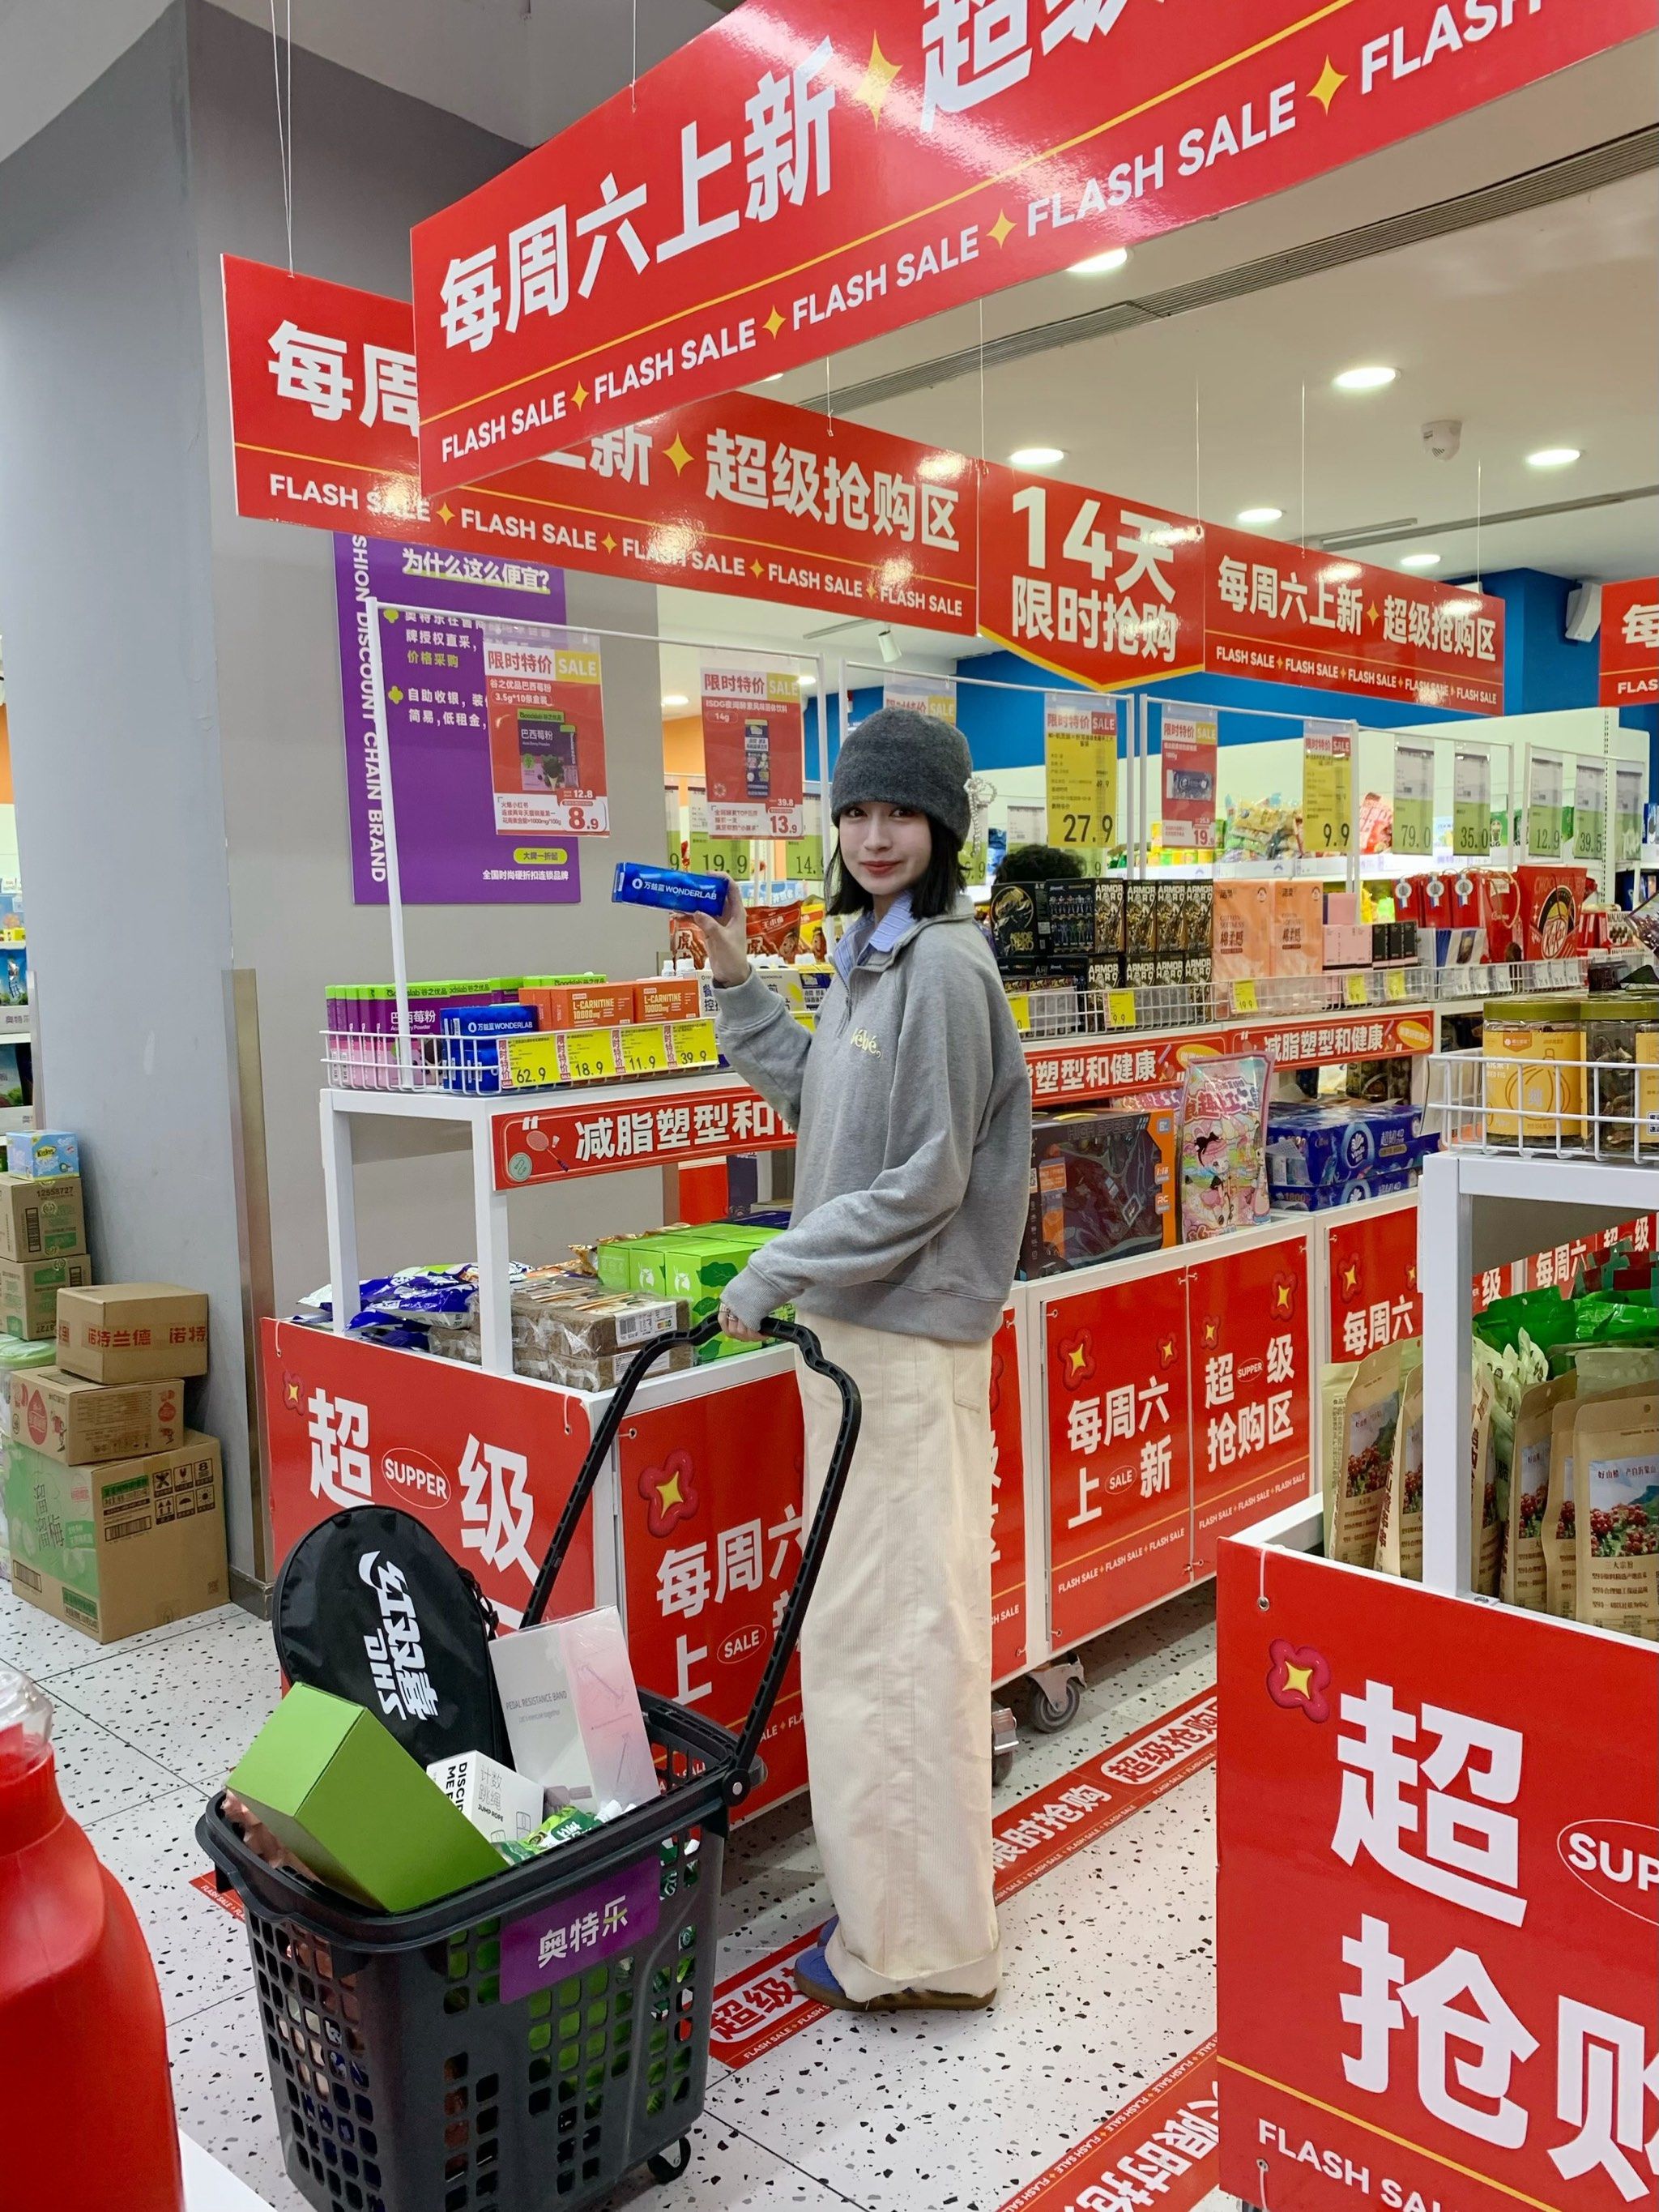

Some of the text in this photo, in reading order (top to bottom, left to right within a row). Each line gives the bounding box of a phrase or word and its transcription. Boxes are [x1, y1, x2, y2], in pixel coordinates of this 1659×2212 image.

[440, 0, 1129, 353] 每周六上新 超
[441, 421, 505, 463] FLASH
[511, 391, 566, 436] SALE
[594, 348, 673, 404] FLASH
[680, 318, 756, 370] SALE
[792, 263, 887, 331] FLASH
[896, 228, 979, 288] SALE
[1026, 144, 1164, 237] FLASH
[1177, 80, 1297, 177] SALE
[705, 427, 960, 553] 超级抢购区
[269, 473, 962, 617] FLASH SALE FLASH SALE FLASH SALE FLASH SALE FLASH SALE
[1012, 485, 1177, 604] 14天
[1011, 575, 1177, 663] 限时抢购
[1218, 554, 1496, 662] 每周六上新 超级抢购区
[488, 651, 597, 677] 限时特价 SALE
[1216, 646, 1248, 664] FLASH
[1251, 652, 1275, 669] SALE
[1285, 657, 1314, 677] FLASH
[1316, 663, 1338, 679] SALE
[1348, 668, 1375, 685] FLASH
[1376, 673, 1397, 688] SALE
[1456, 687, 1479, 702] FLASH
[1480, 690, 1497, 705] SALE
[705, 673, 799, 696] 限时特价 SALE
[1048, 713, 1115, 731] 限时特价 SALE
[1164, 723, 1216, 740] 限时特价 SALE
[356, 611, 386, 882] DISCOUNT CHAIN BRAND
[1333, 739, 1350, 752] SALE
[574, 790, 593, 798] 12.8
[569, 807, 599, 830] 8.9
[770, 815, 797, 834] 13.9
[1063, 814, 1114, 843] 27.9
[1193, 829, 1214, 846] 19.9
[1324, 822, 1350, 847] 9.9
[1401, 824, 1431, 848] 79.0
[1461, 826, 1489, 849] 35.0
[702, 853, 748, 874] 19.9
[665, 885, 717, 901] WONDERLAB
[1095, 884, 1123, 893] ARMOR
[1127, 885, 1155, 894] ARMOR
[1158, 885, 1185, 894] ARMOR
[1187, 885, 1213, 894] ARMOR
[1089, 964, 1119, 973] ARMOR
[1127, 963, 1154, 972] ARMOR
[1157, 963, 1183, 971] ARMOR
[1186, 959, 1211, 969] ARMOR
[573, 998, 614, 1010] L-CARNITINE
[644, 993, 681, 1004] L-CARNITINE
[495, 1021, 533, 1031] WONDERLAB
[1113, 1014, 1125, 1023] 9.9
[1264, 1023, 1384, 1062] 减脂塑型和健康
[575, 1061, 603, 1077] 18.9
[629, 1056, 655, 1071] 11.9
[680, 1050, 706, 1065] 39.9
[516, 1067, 546, 1083] 62.9
[1026, 1049, 1157, 1095] 塑型和健康
[574, 1100, 797, 1162] 减脂塑型和
[1635, 1216, 1649, 1252] 级
[1536, 1239, 1587, 1288] 每周六
[1482, 1267, 1502, 1306] 级
[88, 1327, 151, 1347] 诺特兰德
[1343, 1295, 1413, 1356] 每周六
[1205, 1334, 1294, 1409] 超 SUPPER 级
[1068, 1375, 1170, 1455] 每周六
[1208, 1390, 1294, 1472] 抢购区
[308, 1387, 539, 1585] 超 SUPPER 级
[1068, 1434, 1173, 1530] 上 SALE 新
[1199, 1472, 1306, 1530] FLASH SALE FLASH SALE FLASH SALE
[656, 1503, 805, 1619] 每周六
[1058, 1528, 1185, 1594] FLASH SALE FLASH SALE FLASH SALE
[1000, 1603, 1020, 1621] SALE
[363, 1628, 407, 1721] DHS
[672, 1629, 760, 1706] 上 SALE
[505, 1690, 567, 1710] PEDAL RESISTANCE BAND
[480, 1764, 502, 1791] 计数
[478, 1784, 501, 1811] 跳绳
[1332, 1678, 1528, 1928] 超
[478, 1804, 504, 1822] JUMP ROPE
[993, 1783, 1113, 1875] 限时抢购
[539, 1895, 628, 1969] 奥特乐
[710, 1966, 809, 2040] 超级
[744, 2007, 824, 2059] FLASH SALE FLASH
[1026, 2040, 1214, 2200] SALE FLASH SALE FLASH SALE FLASH SALE FLASH
[1258, 2117, 1441, 2212] FLASH SA
